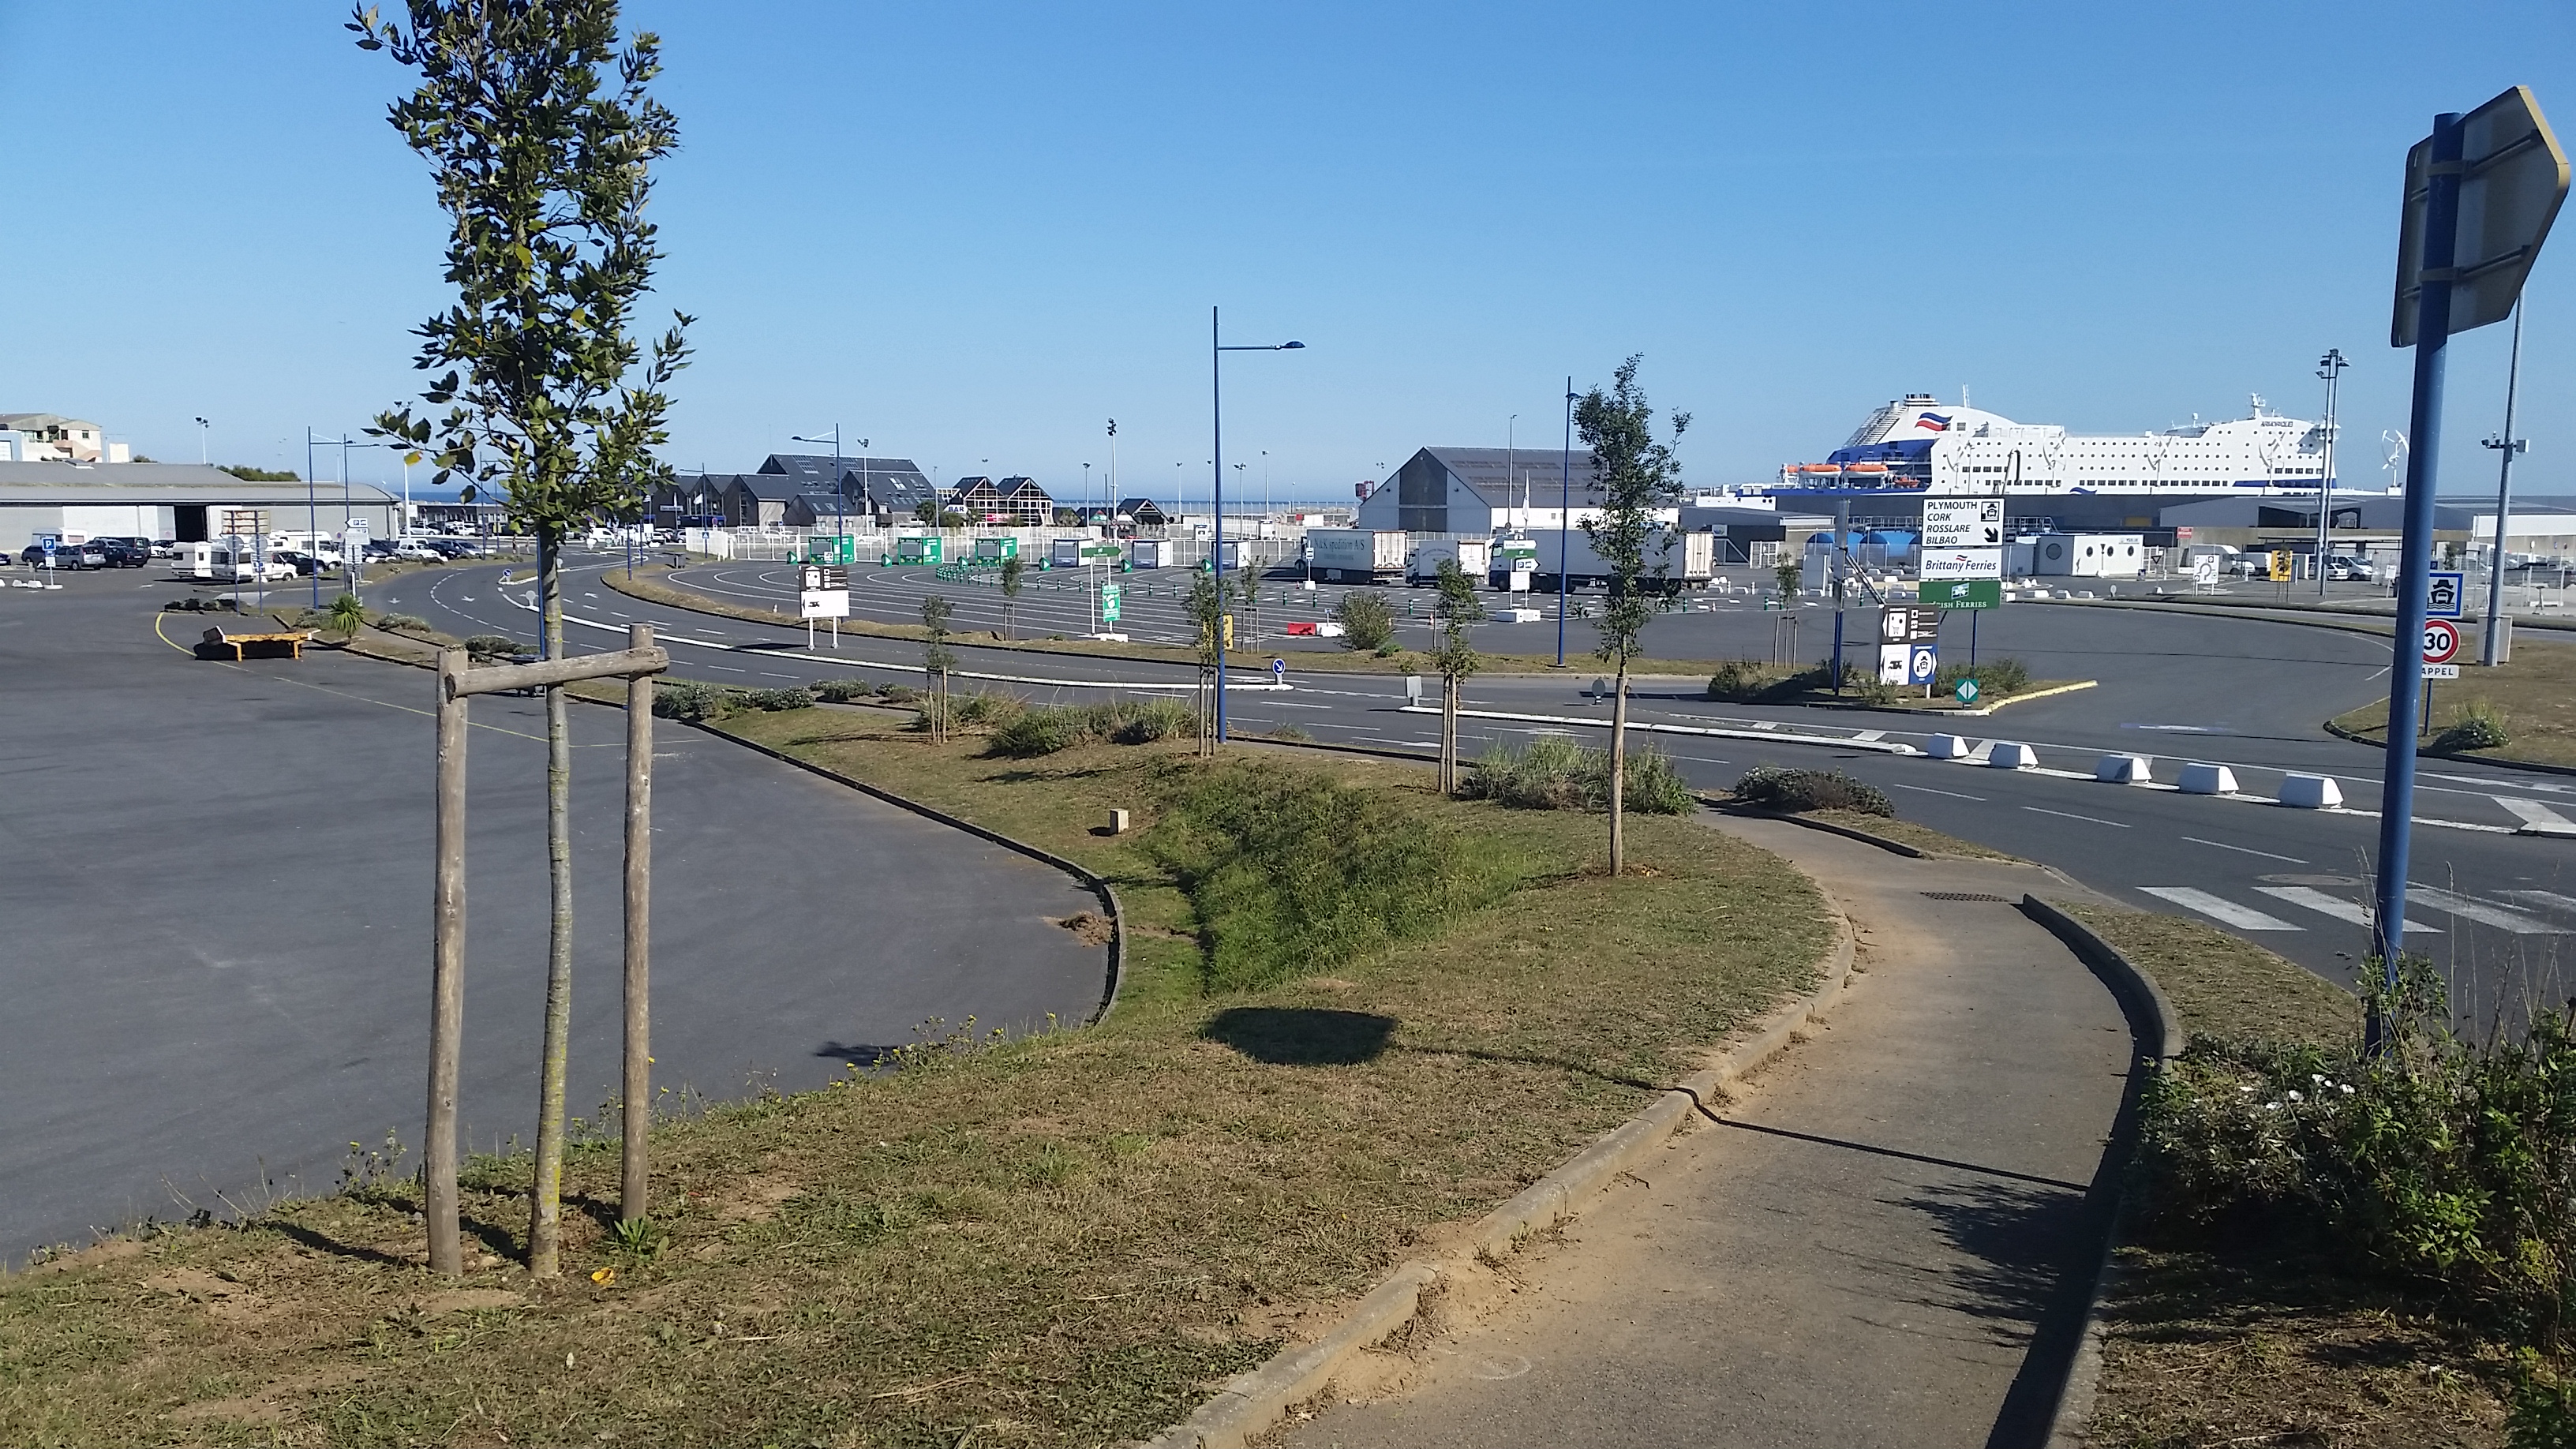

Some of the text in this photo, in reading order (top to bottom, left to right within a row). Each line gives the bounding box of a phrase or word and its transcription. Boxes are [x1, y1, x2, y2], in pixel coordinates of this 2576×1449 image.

[1927, 501, 1978, 510] PLYMOUTH
[1926, 513, 1952, 522] CORK
[1926, 524, 1971, 533] ROSSLARE
[1926, 536, 1958, 545] BILBAO
[1926, 560, 1997, 573] Brittany Ferries
[1956, 600, 1987, 608] FERRIES
[2423, 632, 2451, 651] 30
[2421, 667, 2454, 676] APPEL
